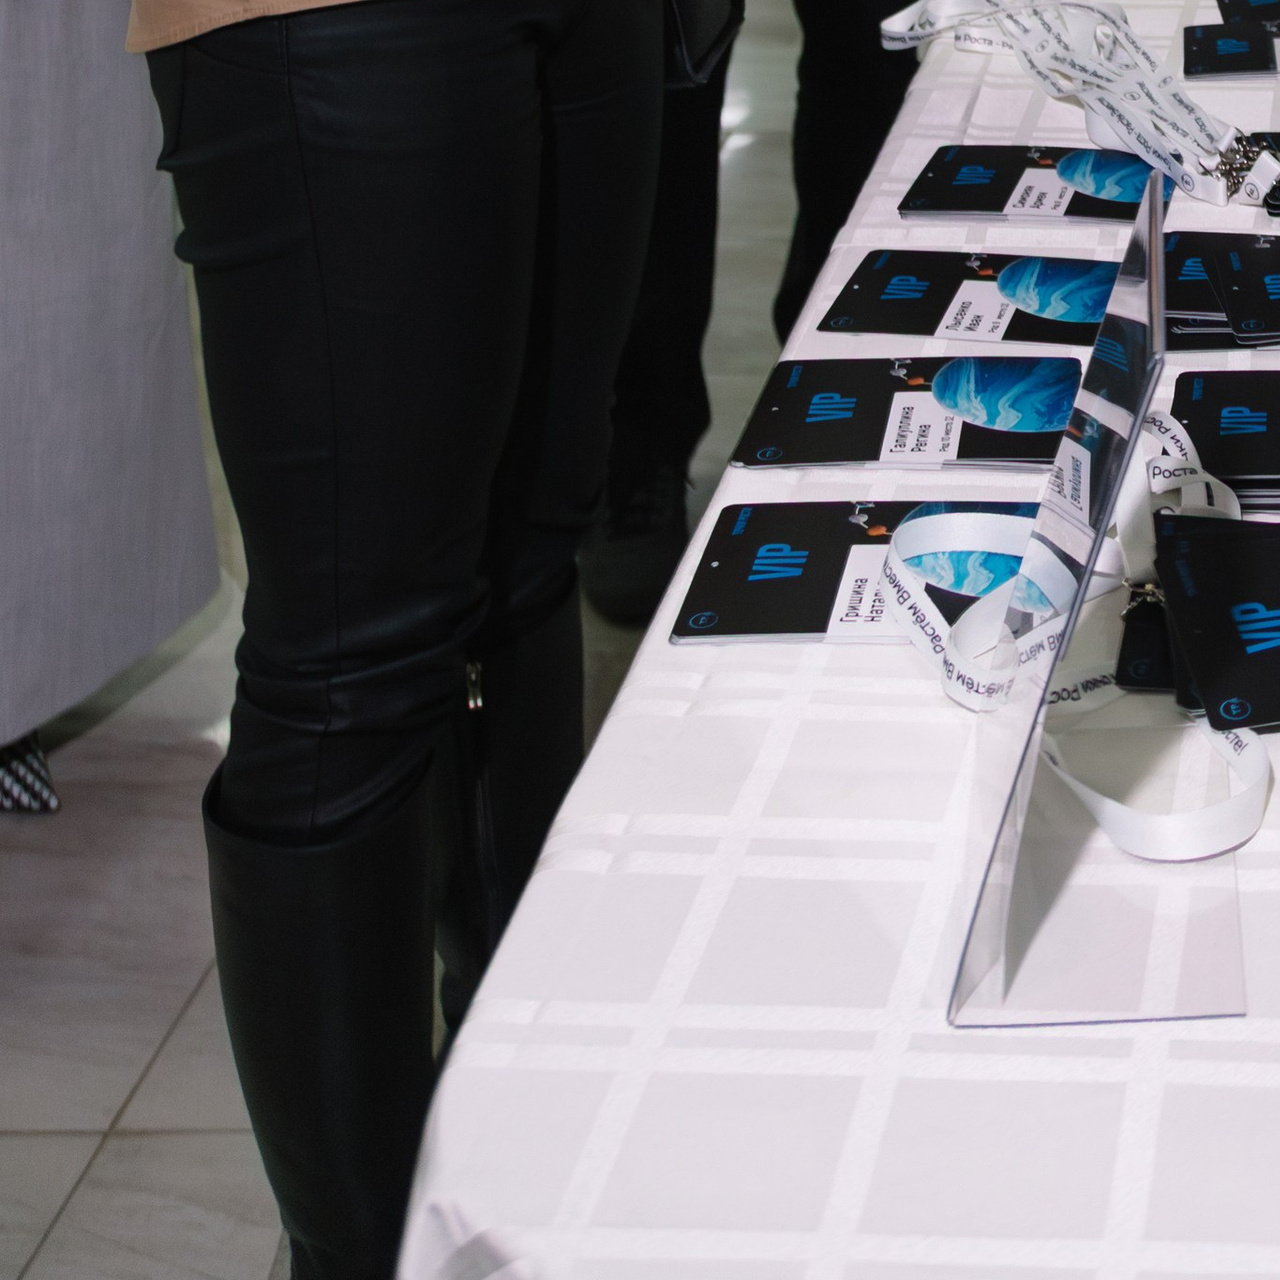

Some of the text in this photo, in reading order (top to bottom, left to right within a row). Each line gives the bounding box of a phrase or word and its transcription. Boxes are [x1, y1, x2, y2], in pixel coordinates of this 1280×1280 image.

[952, 165, 997, 185] VIP
[881, 275, 930, 300] VIP
[946, 300, 972, 332] Лысенко
[964, 314, 984, 333] Иван
[805, 393, 859, 423] VIP
[1219, 406, 1268, 436] VIP
[890, 406, 914, 453] Галикуллина
[911, 424, 931, 453] Регина
[1144, 416, 1190, 461] чки Рос
[1152, 465, 1198, 479] Роста
[747, 543, 810, 582] VIP
[840, 578, 868, 623] Гришина
[907, 603, 945, 654] Растём
